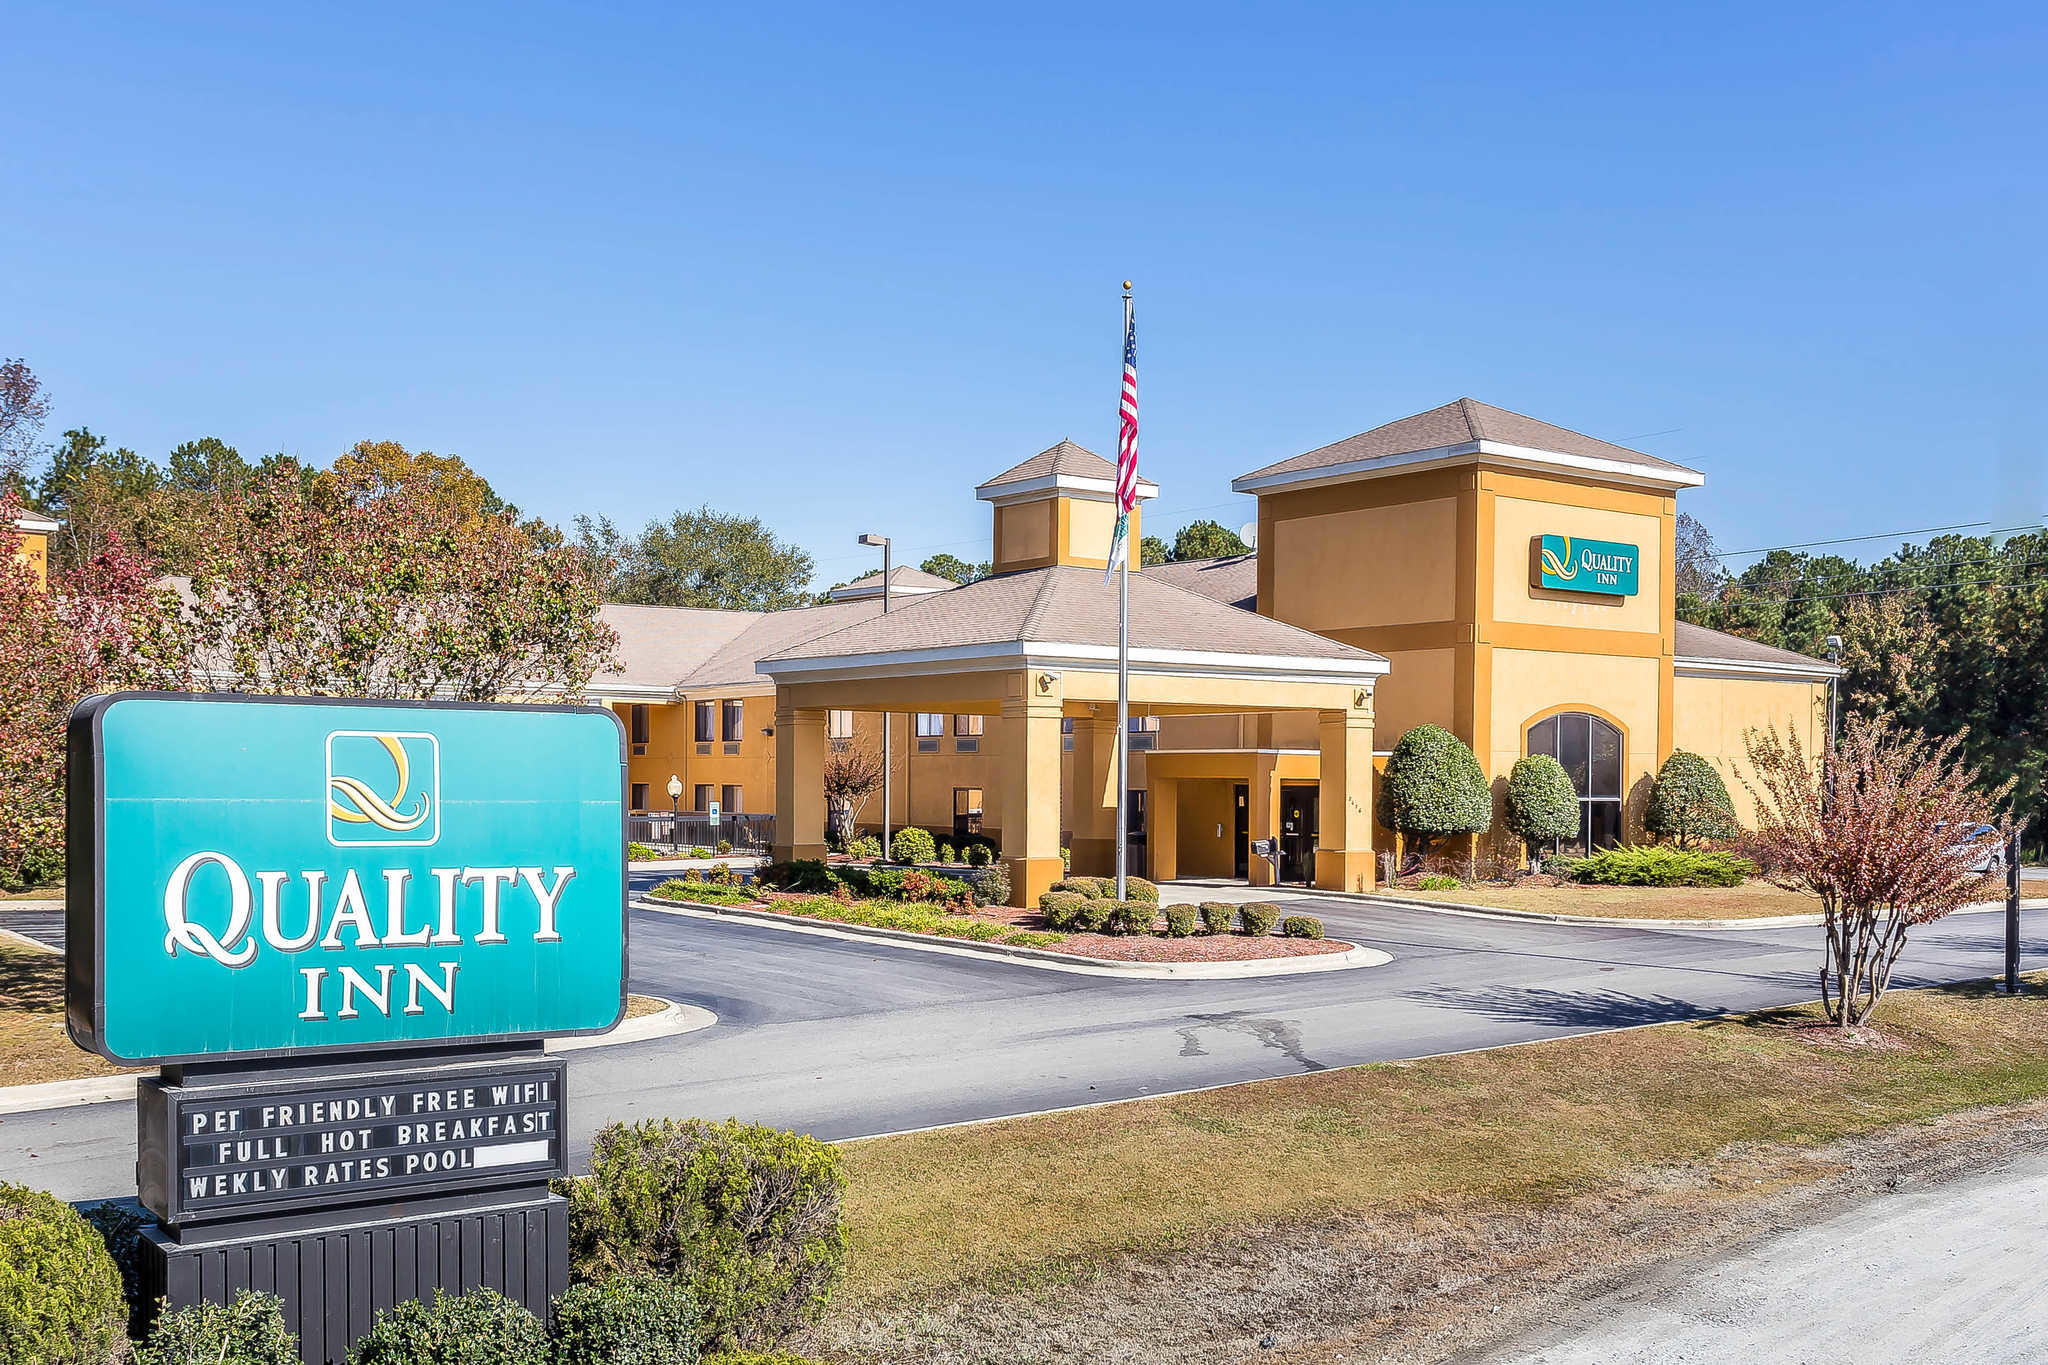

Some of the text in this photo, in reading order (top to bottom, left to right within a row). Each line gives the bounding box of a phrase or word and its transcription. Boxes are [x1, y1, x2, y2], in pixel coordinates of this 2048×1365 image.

[1581, 549, 1633, 573] QUALITY
[1597, 574, 1618, 585] INN
[163, 850, 577, 969] QUALITY
[298, 960, 461, 1022] INN
[192, 1081, 549, 1134] PET FRIENDLY FREE WIFI
[219, 1111, 550, 1164] FULL HOT BREAKFAST
[189, 1148, 472, 1199] WEKLY RATES POOL
